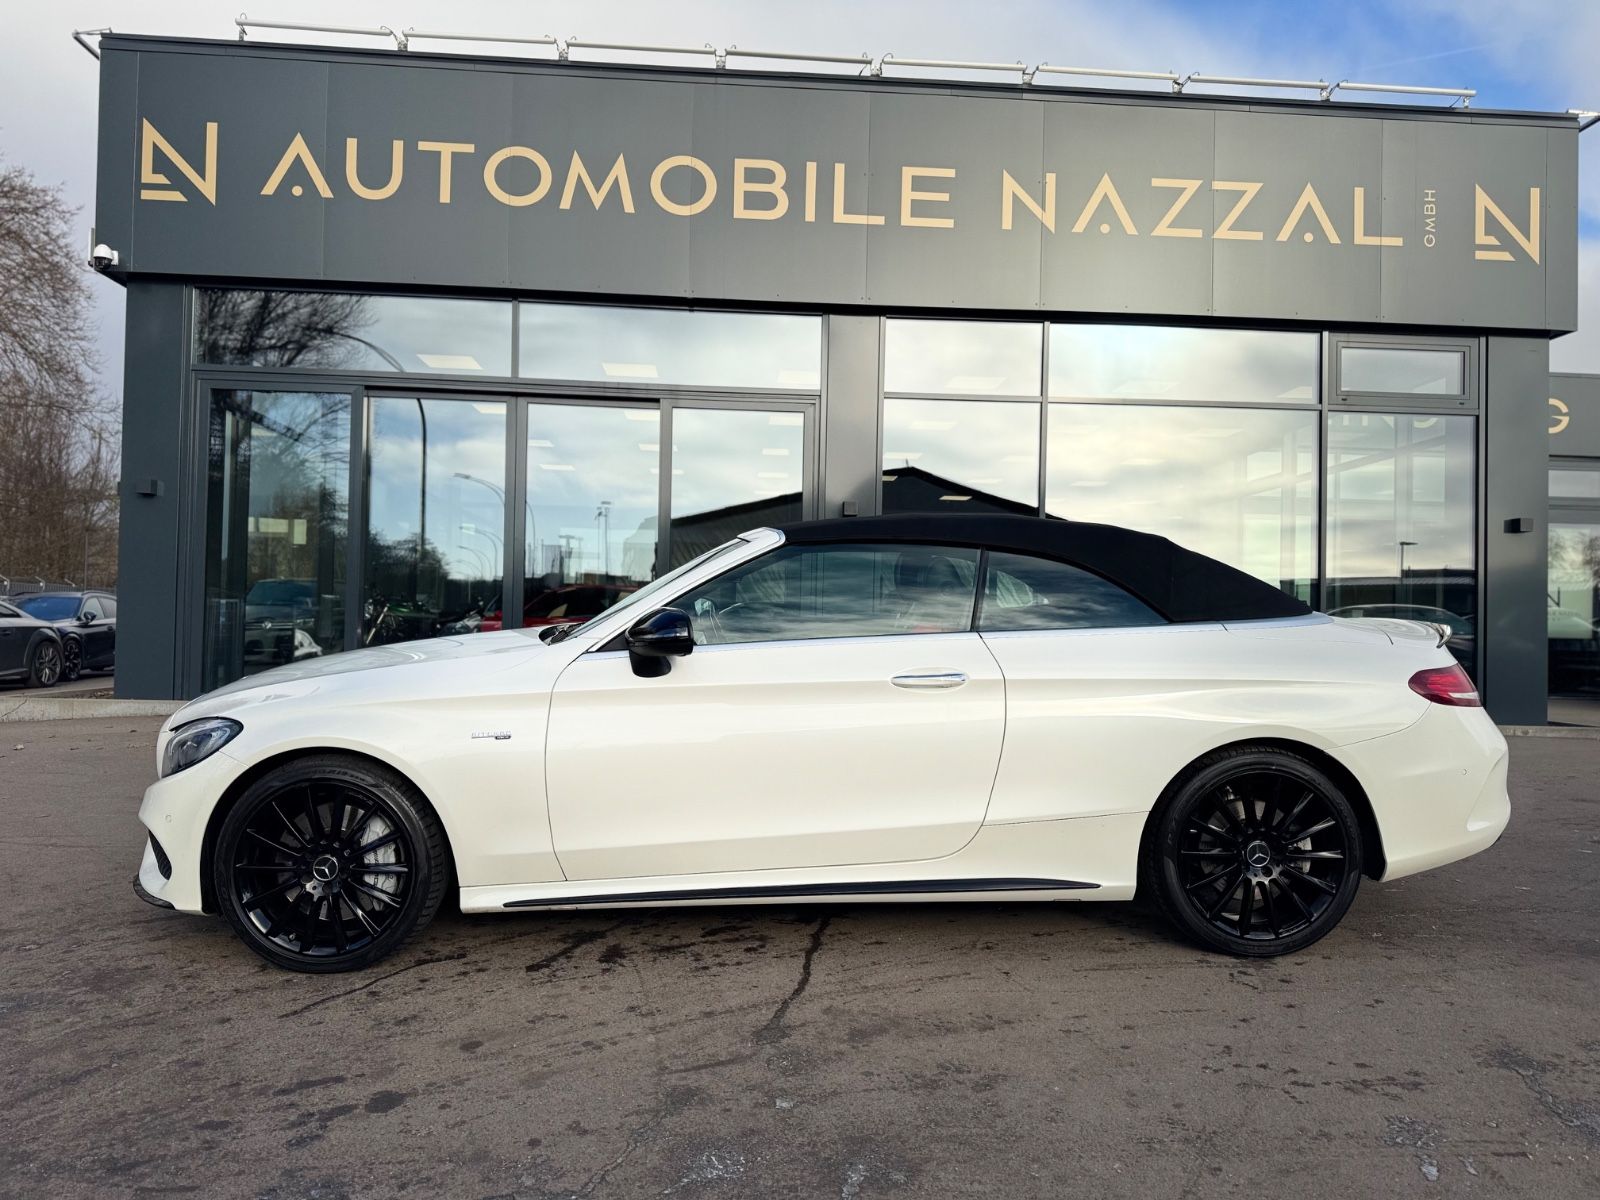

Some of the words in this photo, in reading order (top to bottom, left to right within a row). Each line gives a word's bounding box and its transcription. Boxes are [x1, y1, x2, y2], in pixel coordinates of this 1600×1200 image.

[261, 133, 957, 230] AUTOMOBILE
[1000, 169, 1404, 248] NAZZAL
[1423, 189, 1436, 247] GMBH
